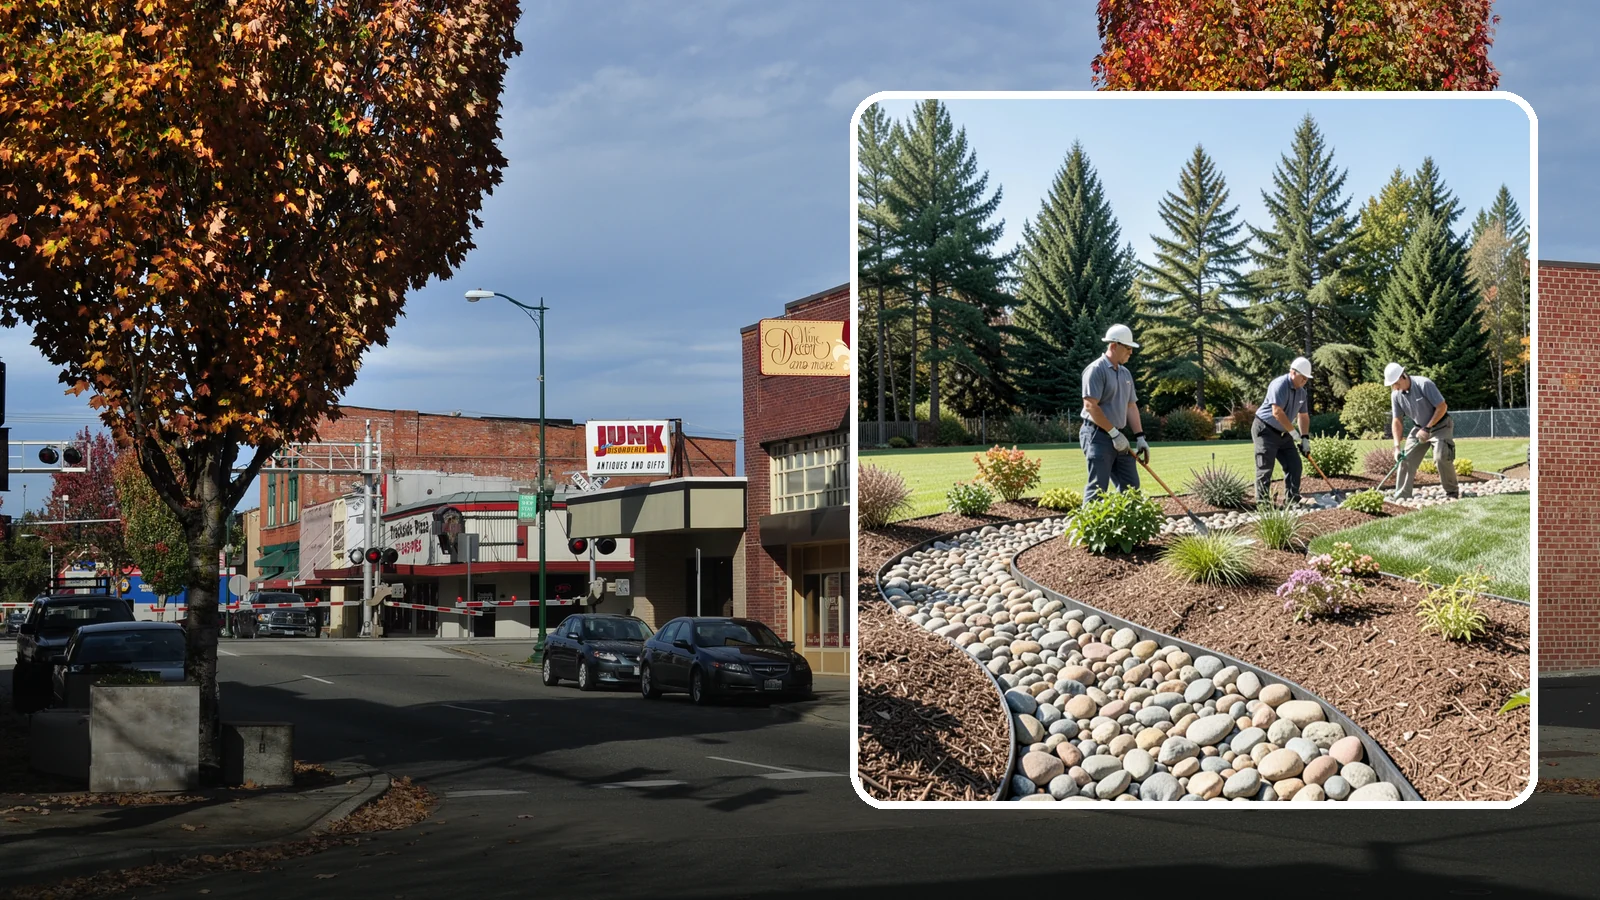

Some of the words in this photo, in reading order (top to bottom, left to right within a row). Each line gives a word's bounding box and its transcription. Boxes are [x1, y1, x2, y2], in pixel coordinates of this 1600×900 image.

[595, 425, 665, 457] JUNK
[607, 446, 646, 454] DISORDERLY
[597, 461, 628, 470] ANTIQUES
[631, 461, 644, 469] AND
[647, 460, 665, 469] GIFTS
[352, 498, 365, 510] CRO
